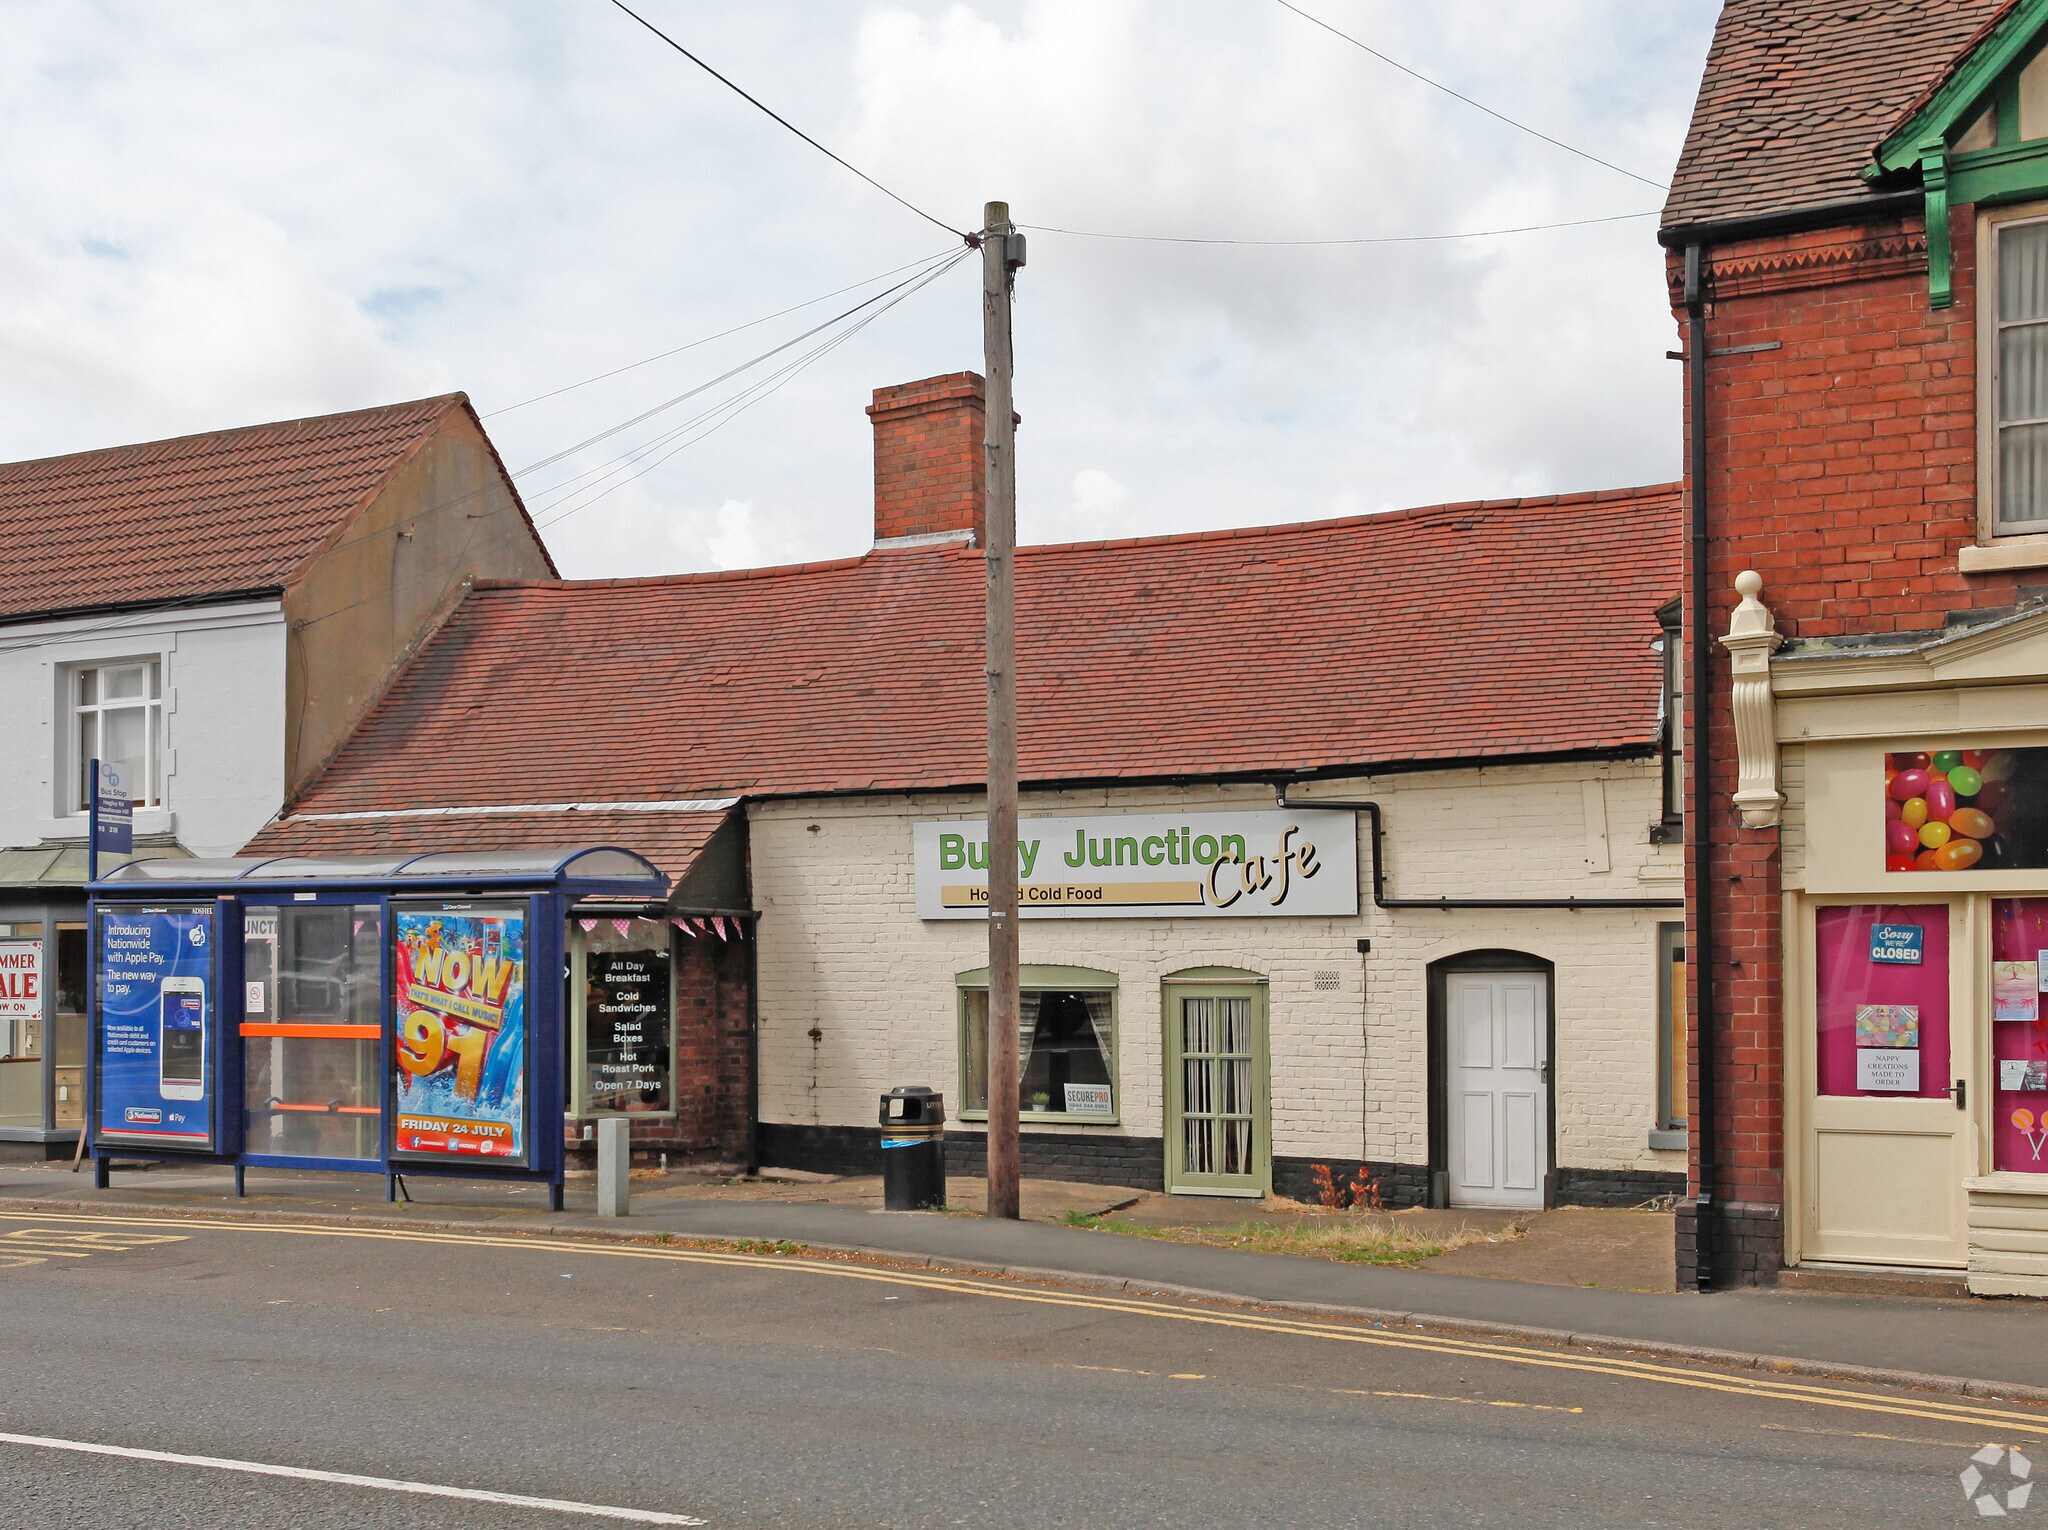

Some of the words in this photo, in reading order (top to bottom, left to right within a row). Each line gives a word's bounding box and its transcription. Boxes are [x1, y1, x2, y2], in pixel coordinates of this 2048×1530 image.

[113, 789, 127, 798] Stop
[940, 833, 1040, 878] Buy
[1064, 826, 1246, 867] Junction
[1206, 825, 1321, 908] Cafe
[970, 888, 989, 900] Ho
[1029, 887, 1062, 900] Cold
[1067, 886, 1102, 900] Food
[108, 925, 151, 938] Introducing
[1879, 926, 1914, 944] Sorry
[107, 938, 150, 949] Nationwide
[107, 952, 123, 963] with
[124, 952, 148, 965] Apple
[149, 952, 165, 965] Pay.
[1872, 946, 1920, 960] CLOSED
[610, 961, 623, 970] All
[626, 961, 645, 973] Day
[107, 969, 121, 980] The
[122, 971, 139, 981] new
[140, 972, 157, 983] way
[414, 946, 513, 1004] NOW
[605, 973, 651, 982] Breakfast
[107, 983, 115, 993] to
[115, 985, 131, 996] pay.
[616, 991, 639, 1001] Cold
[14, 1003, 25, 1011] ON
[410, 989, 429, 1002] THAT'S
[430, 994, 449, 1008] WHAT
[453, 1001, 471, 1015] CALL
[471, 1008, 499, 1024] MUSIC!
[599, 1003, 657, 1013] Sandwiches
[614, 1022, 642, 1031] Salad
[613, 1034, 643, 1043] Boxes
[400, 1009, 487, 1101] 91
[620, 1052, 637, 1061] Hot
[602, 1064, 630, 1073] Roast
[632, 1063, 655, 1073] Pork
[1867, 1062, 1909, 1070] CREATIONS
[595, 1080, 623, 1092] Open
[626, 1080, 633, 1089] 7
[635, 1080, 662, 1091] Days
[1067, 1090, 1109, 1104] SECUREPRO
[134, 1111, 160, 1120] Nationwide
[174, 1113, 186, 1124] Pay
[401, 1119, 449, 1133] FRIDAY
[452, 1123, 469, 1135] 24
[471, 1125, 506, 1138] JULY
